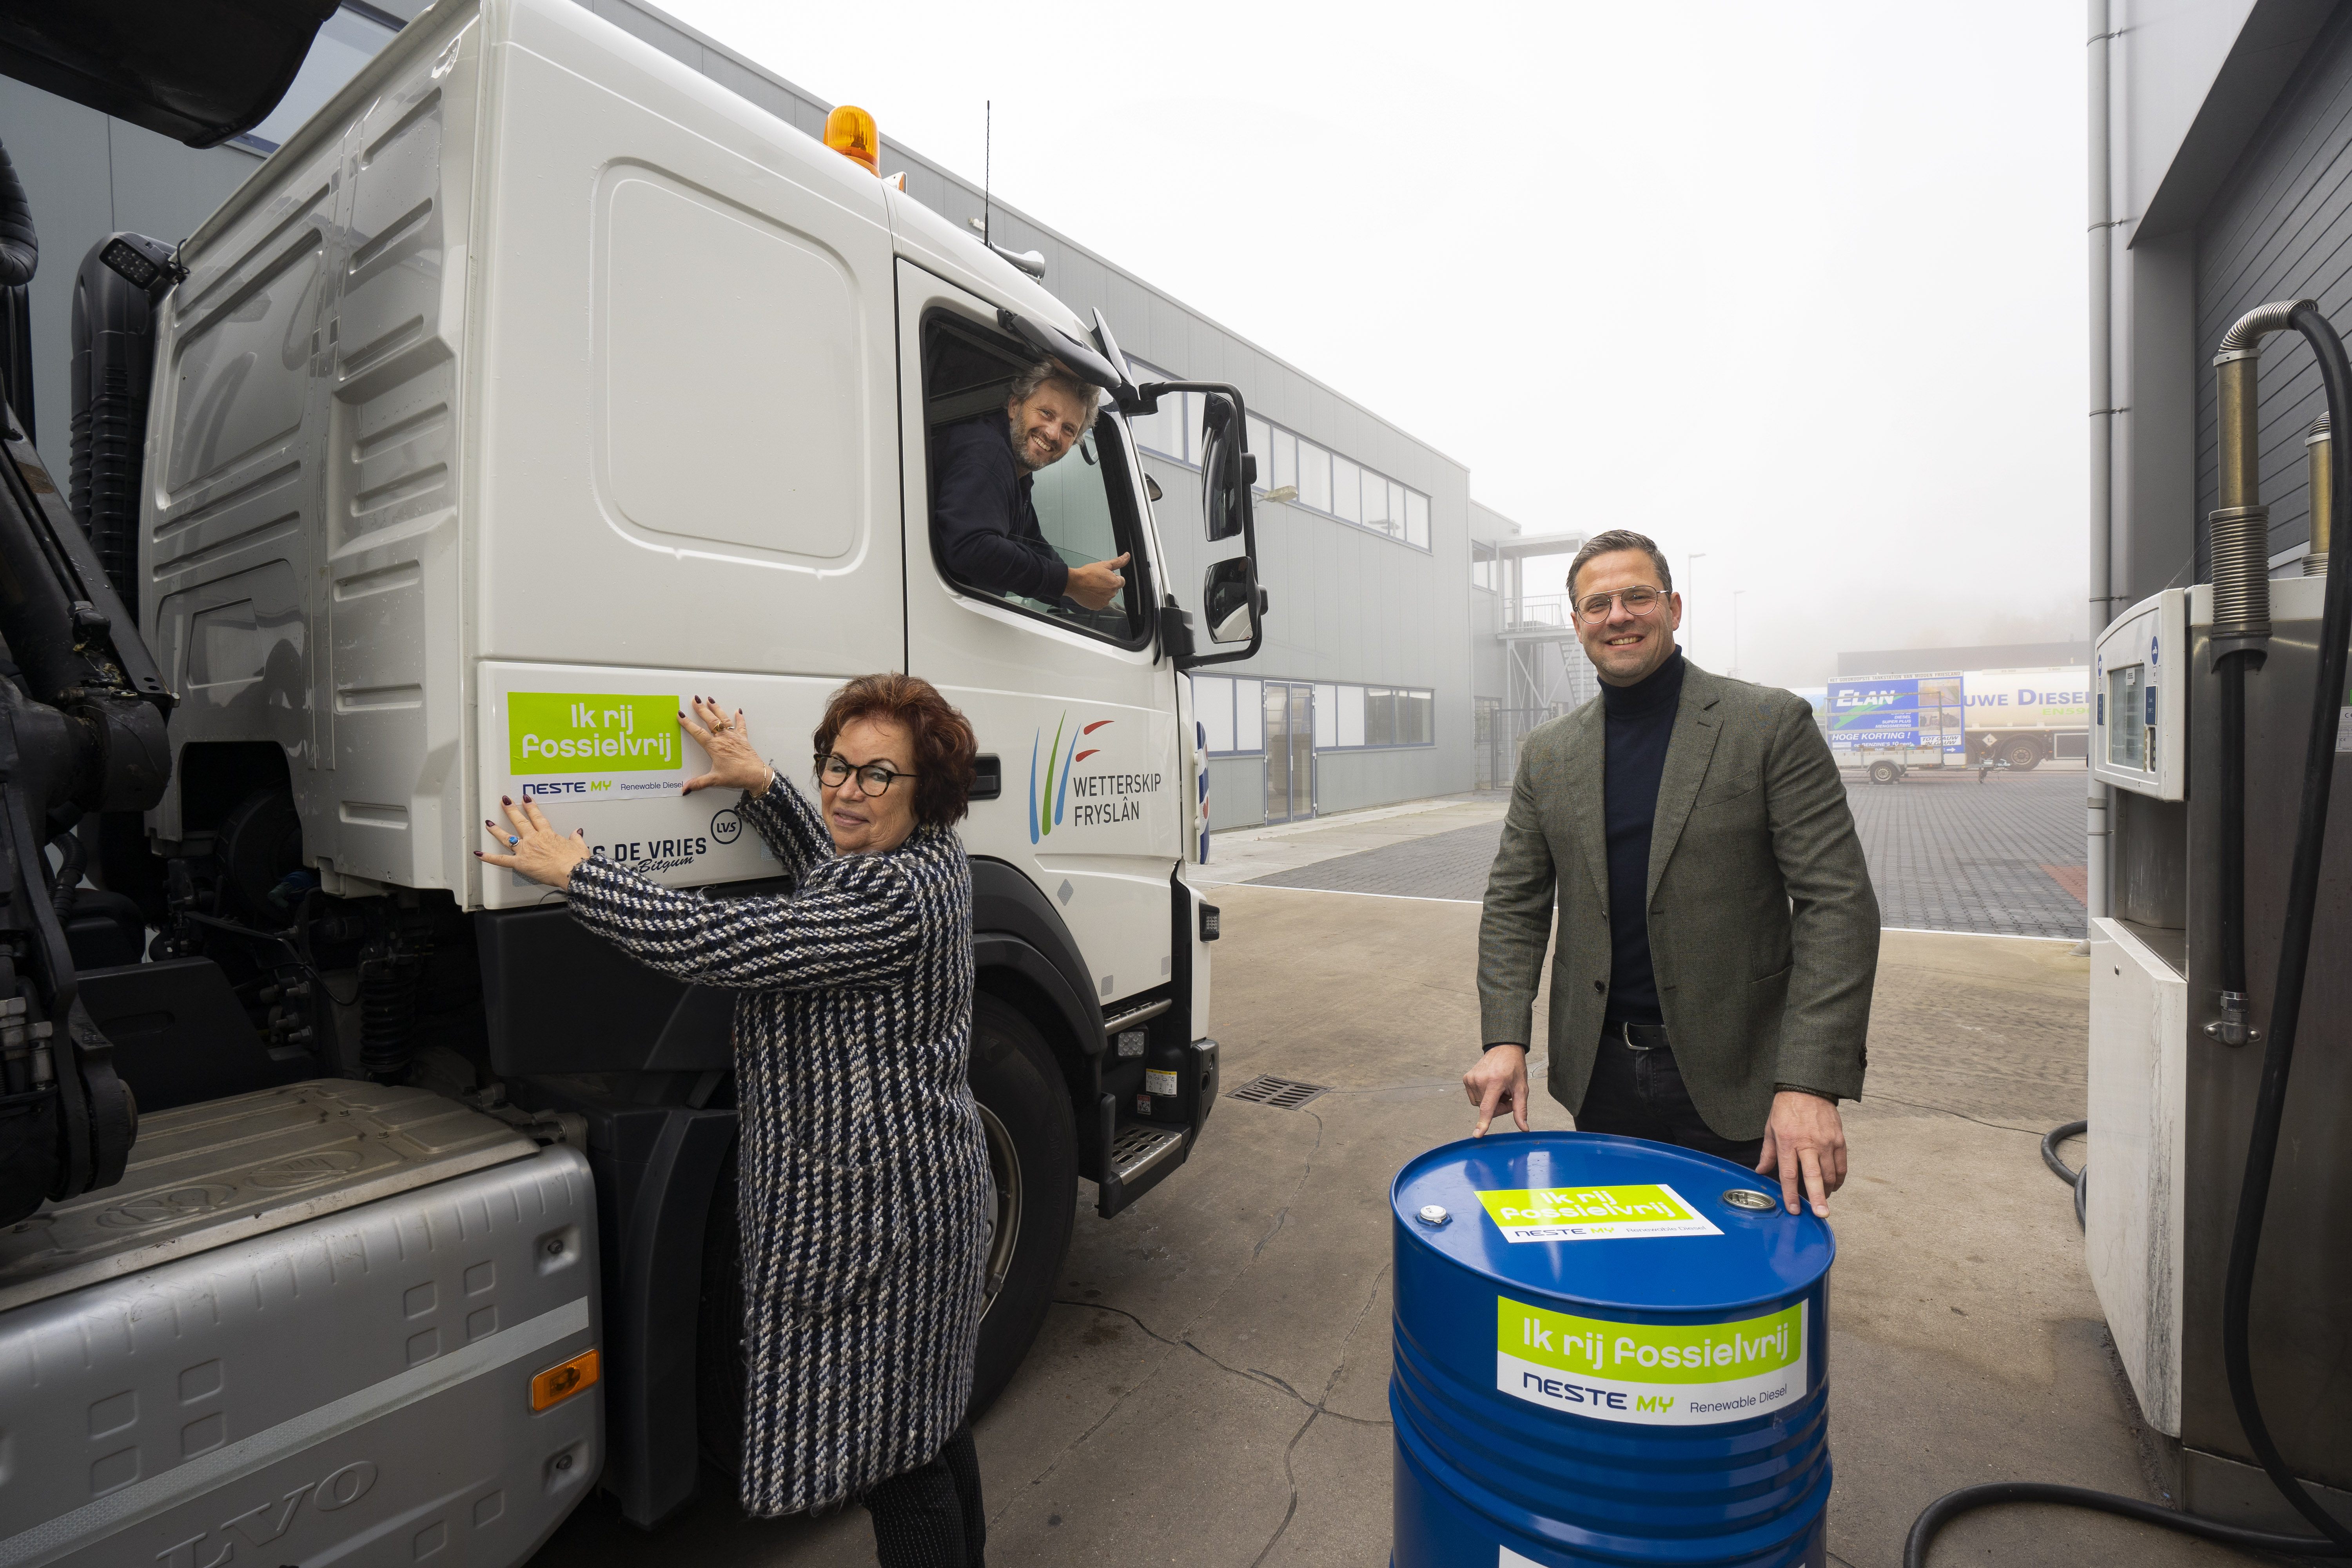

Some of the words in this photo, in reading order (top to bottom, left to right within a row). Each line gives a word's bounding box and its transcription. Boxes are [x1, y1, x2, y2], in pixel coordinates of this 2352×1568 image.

[1836, 690, 1895, 707] ELAN
[571, 702, 597, 728] Ik
[604, 705, 633, 735] rij
[522, 732, 671, 762] fossielvrij
[523, 782, 586, 795] NESTE
[590, 780, 612, 791] MY
[621, 781, 661, 790] Renewable
[1073, 773, 1161, 797] WETTERSKIP
[1074, 797, 1140, 827] FRYSLÂN
[717, 822, 737, 833] LVS
[615, 842, 641, 862] DE
[648, 837, 706, 859] VRIES
[638, 856, 694, 873] Bitgum
[1540, 1191, 1574, 1204] Ik
[1576, 1191, 1617, 1205] rij
[1500, 1201, 1675, 1220] fossielvrij
[1515, 1229, 1587, 1237] NESTE
[1524, 1318, 1553, 1352] Ik
[1564, 1332, 1603, 1370] rij
[1615, 1322, 1788, 1368] fossielvrij
[1523, 1372, 1627, 1410] NESTE
[1636, 1395, 1674, 1413] MY
[1690, 1396, 1756, 1413] Renewable
[1759, 1383, 1787, 1403] Diesel
